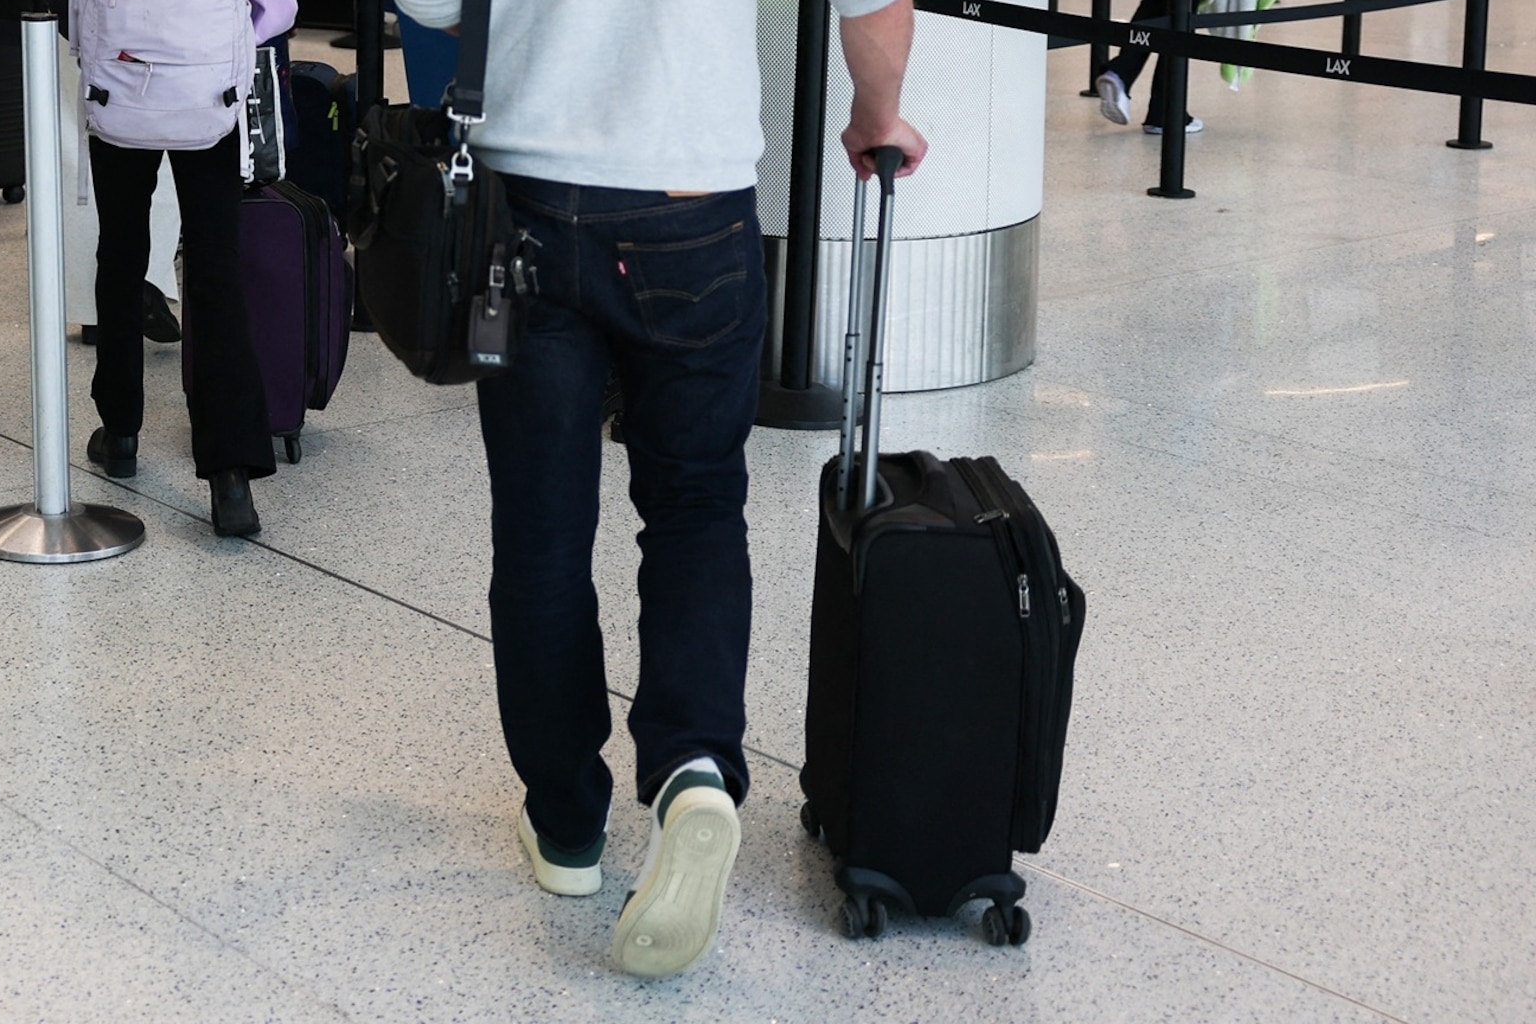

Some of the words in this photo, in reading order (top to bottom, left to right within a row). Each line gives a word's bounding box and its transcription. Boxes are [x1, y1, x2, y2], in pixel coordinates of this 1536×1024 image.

[962, 1, 981, 17] LAX
[1129, 29, 1150, 46] LAX
[1325, 57, 1351, 75] LAX
